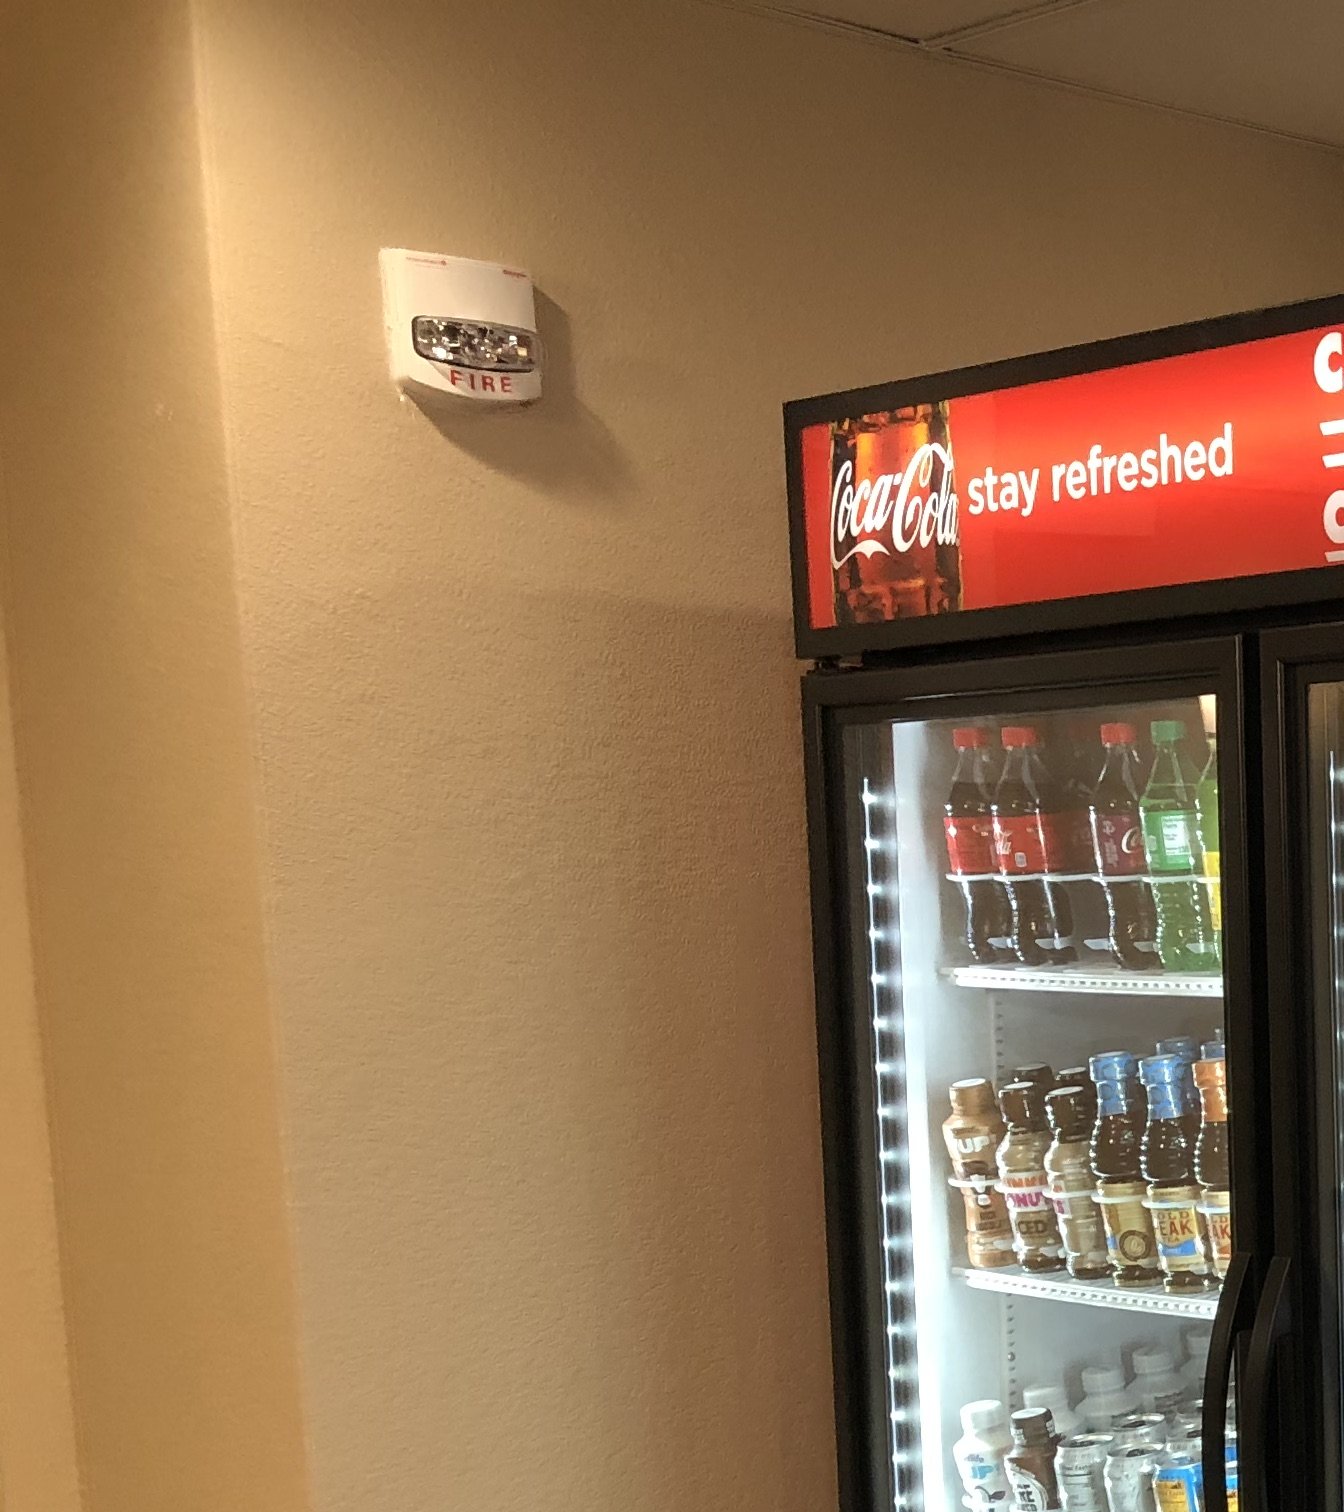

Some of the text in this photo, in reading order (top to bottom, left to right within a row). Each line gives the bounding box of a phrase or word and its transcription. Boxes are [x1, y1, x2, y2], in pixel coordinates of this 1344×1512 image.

[450, 370, 513, 393] FIRE
[967, 422, 1233, 517] stay refreshed
[830, 443, 959, 569] Coca-Cola
[1160, 1219, 1194, 1236] EAK
